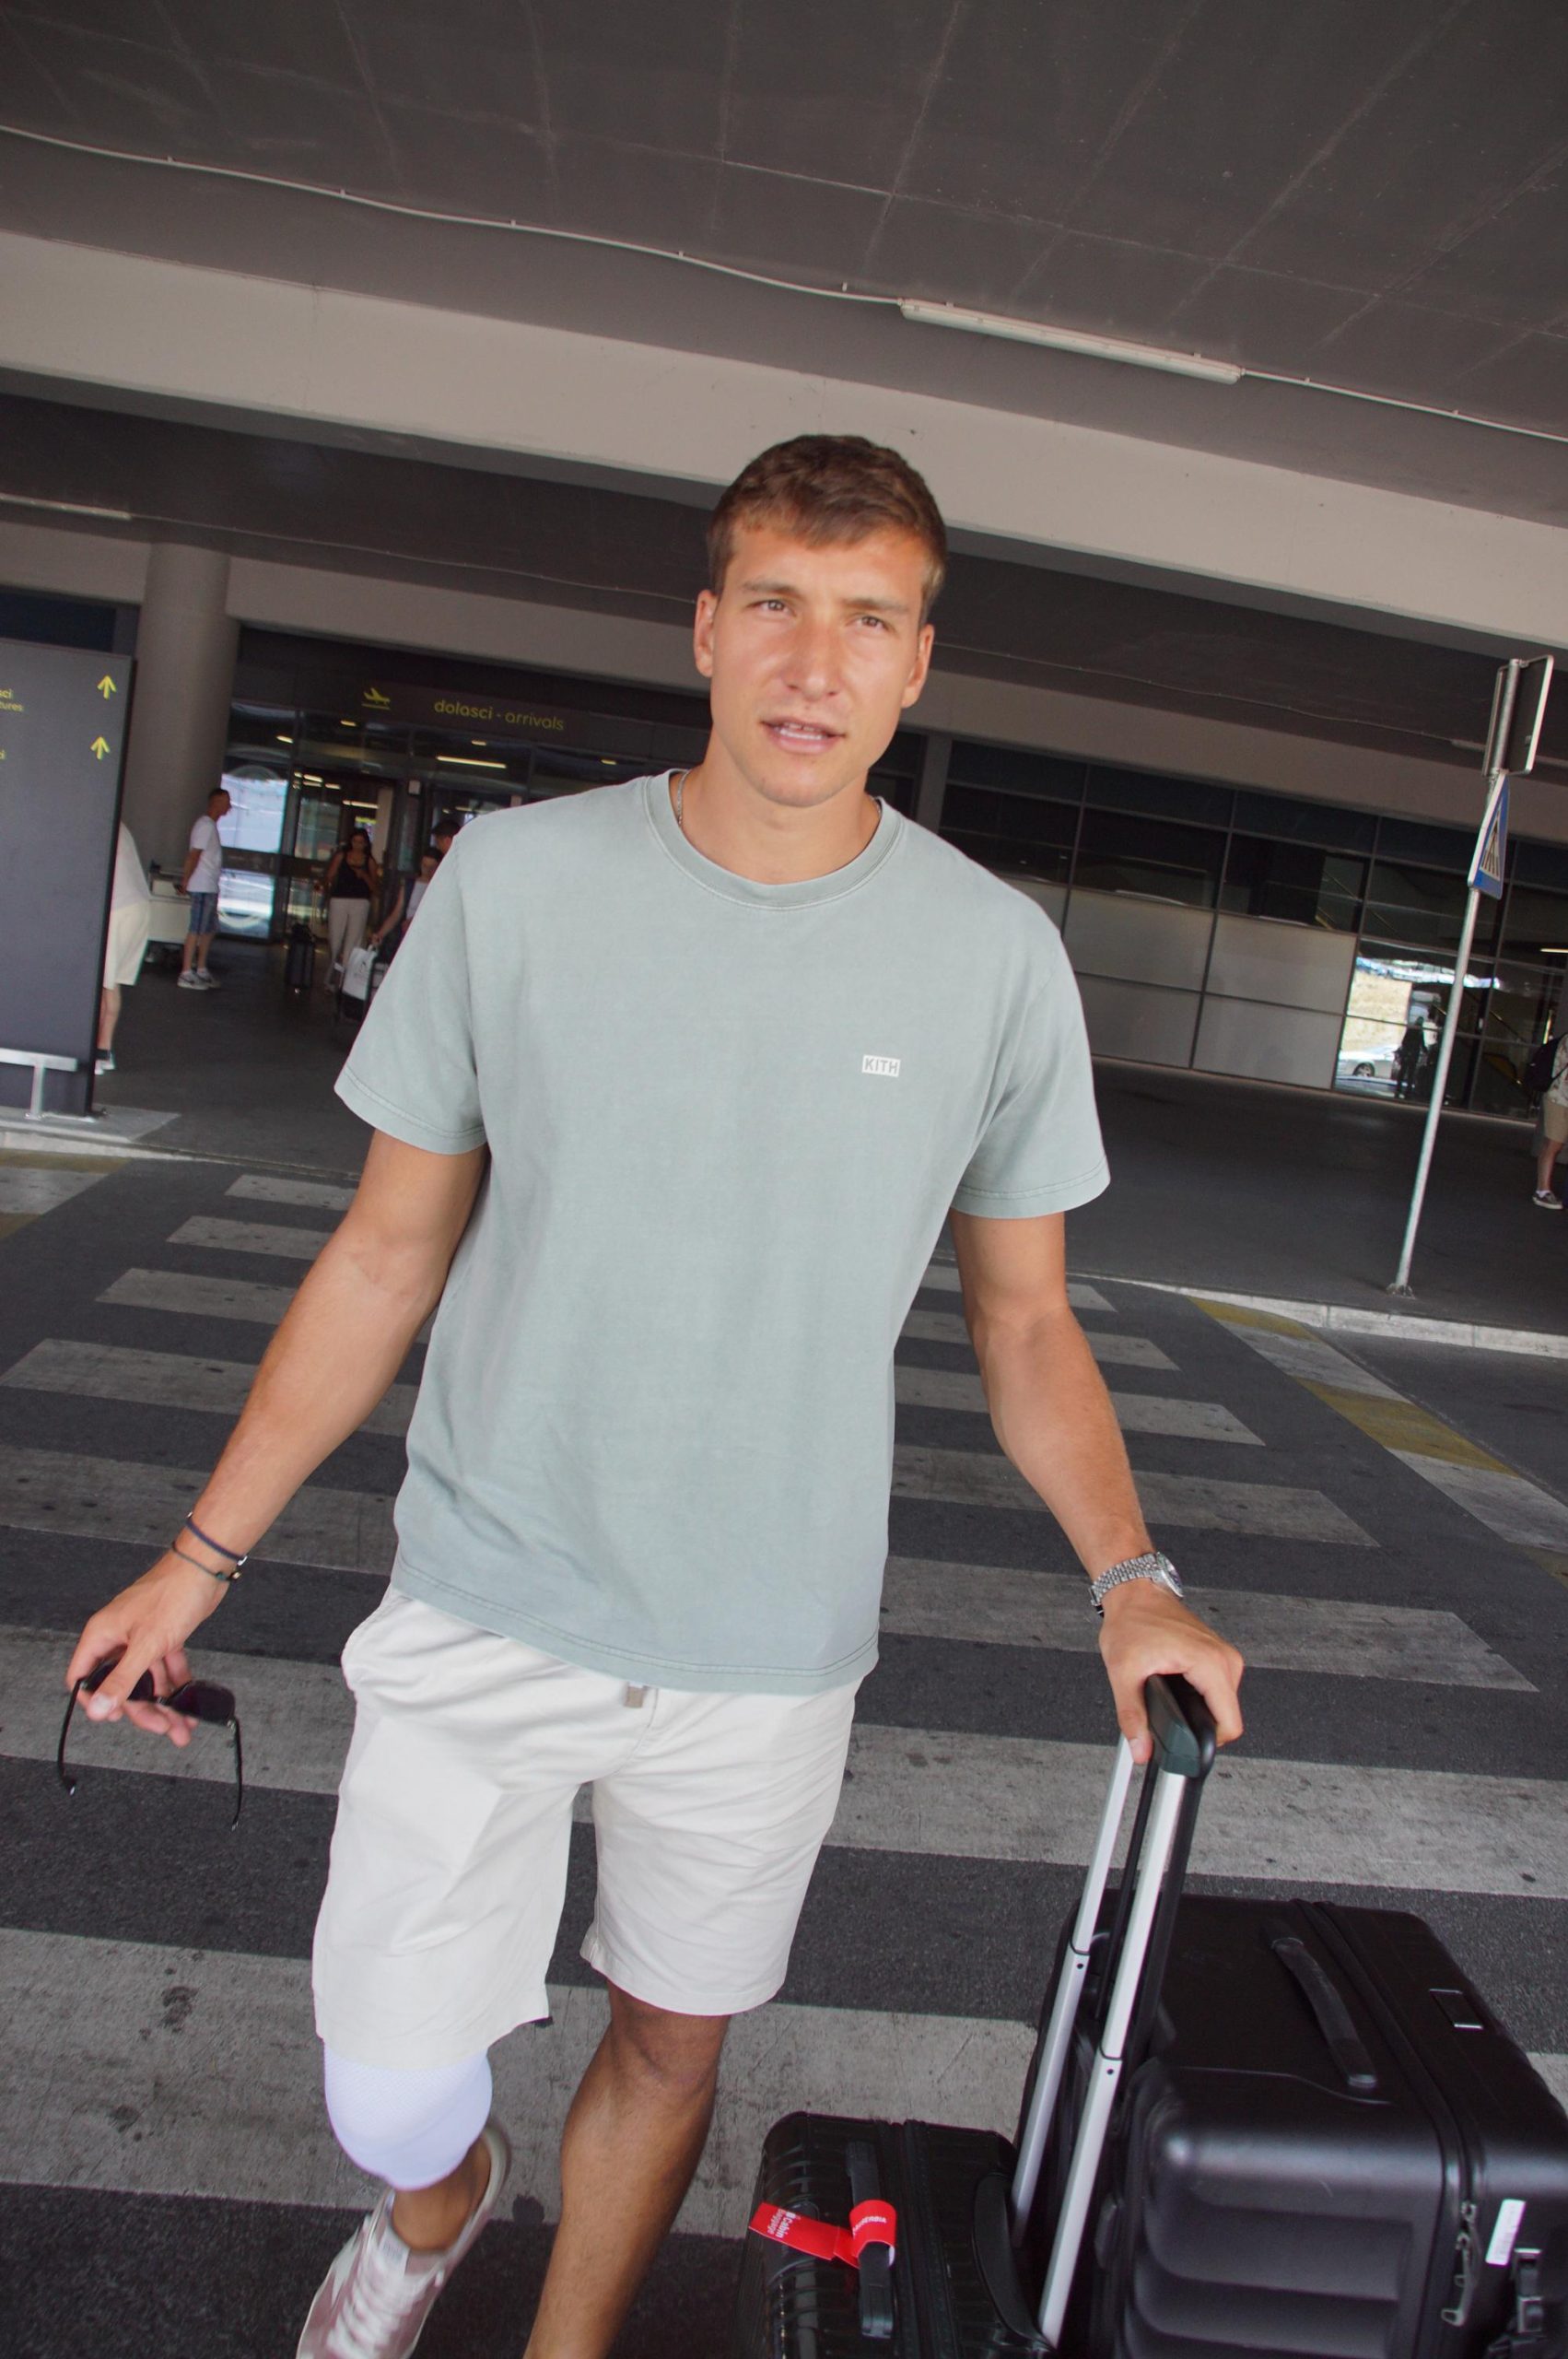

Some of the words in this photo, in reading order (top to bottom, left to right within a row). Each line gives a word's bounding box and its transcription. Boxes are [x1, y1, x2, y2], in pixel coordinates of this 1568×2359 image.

[434, 699, 493, 720] dolasci
[505, 711, 565, 731] arrivals
[864, 1057, 899, 1075] KITH
